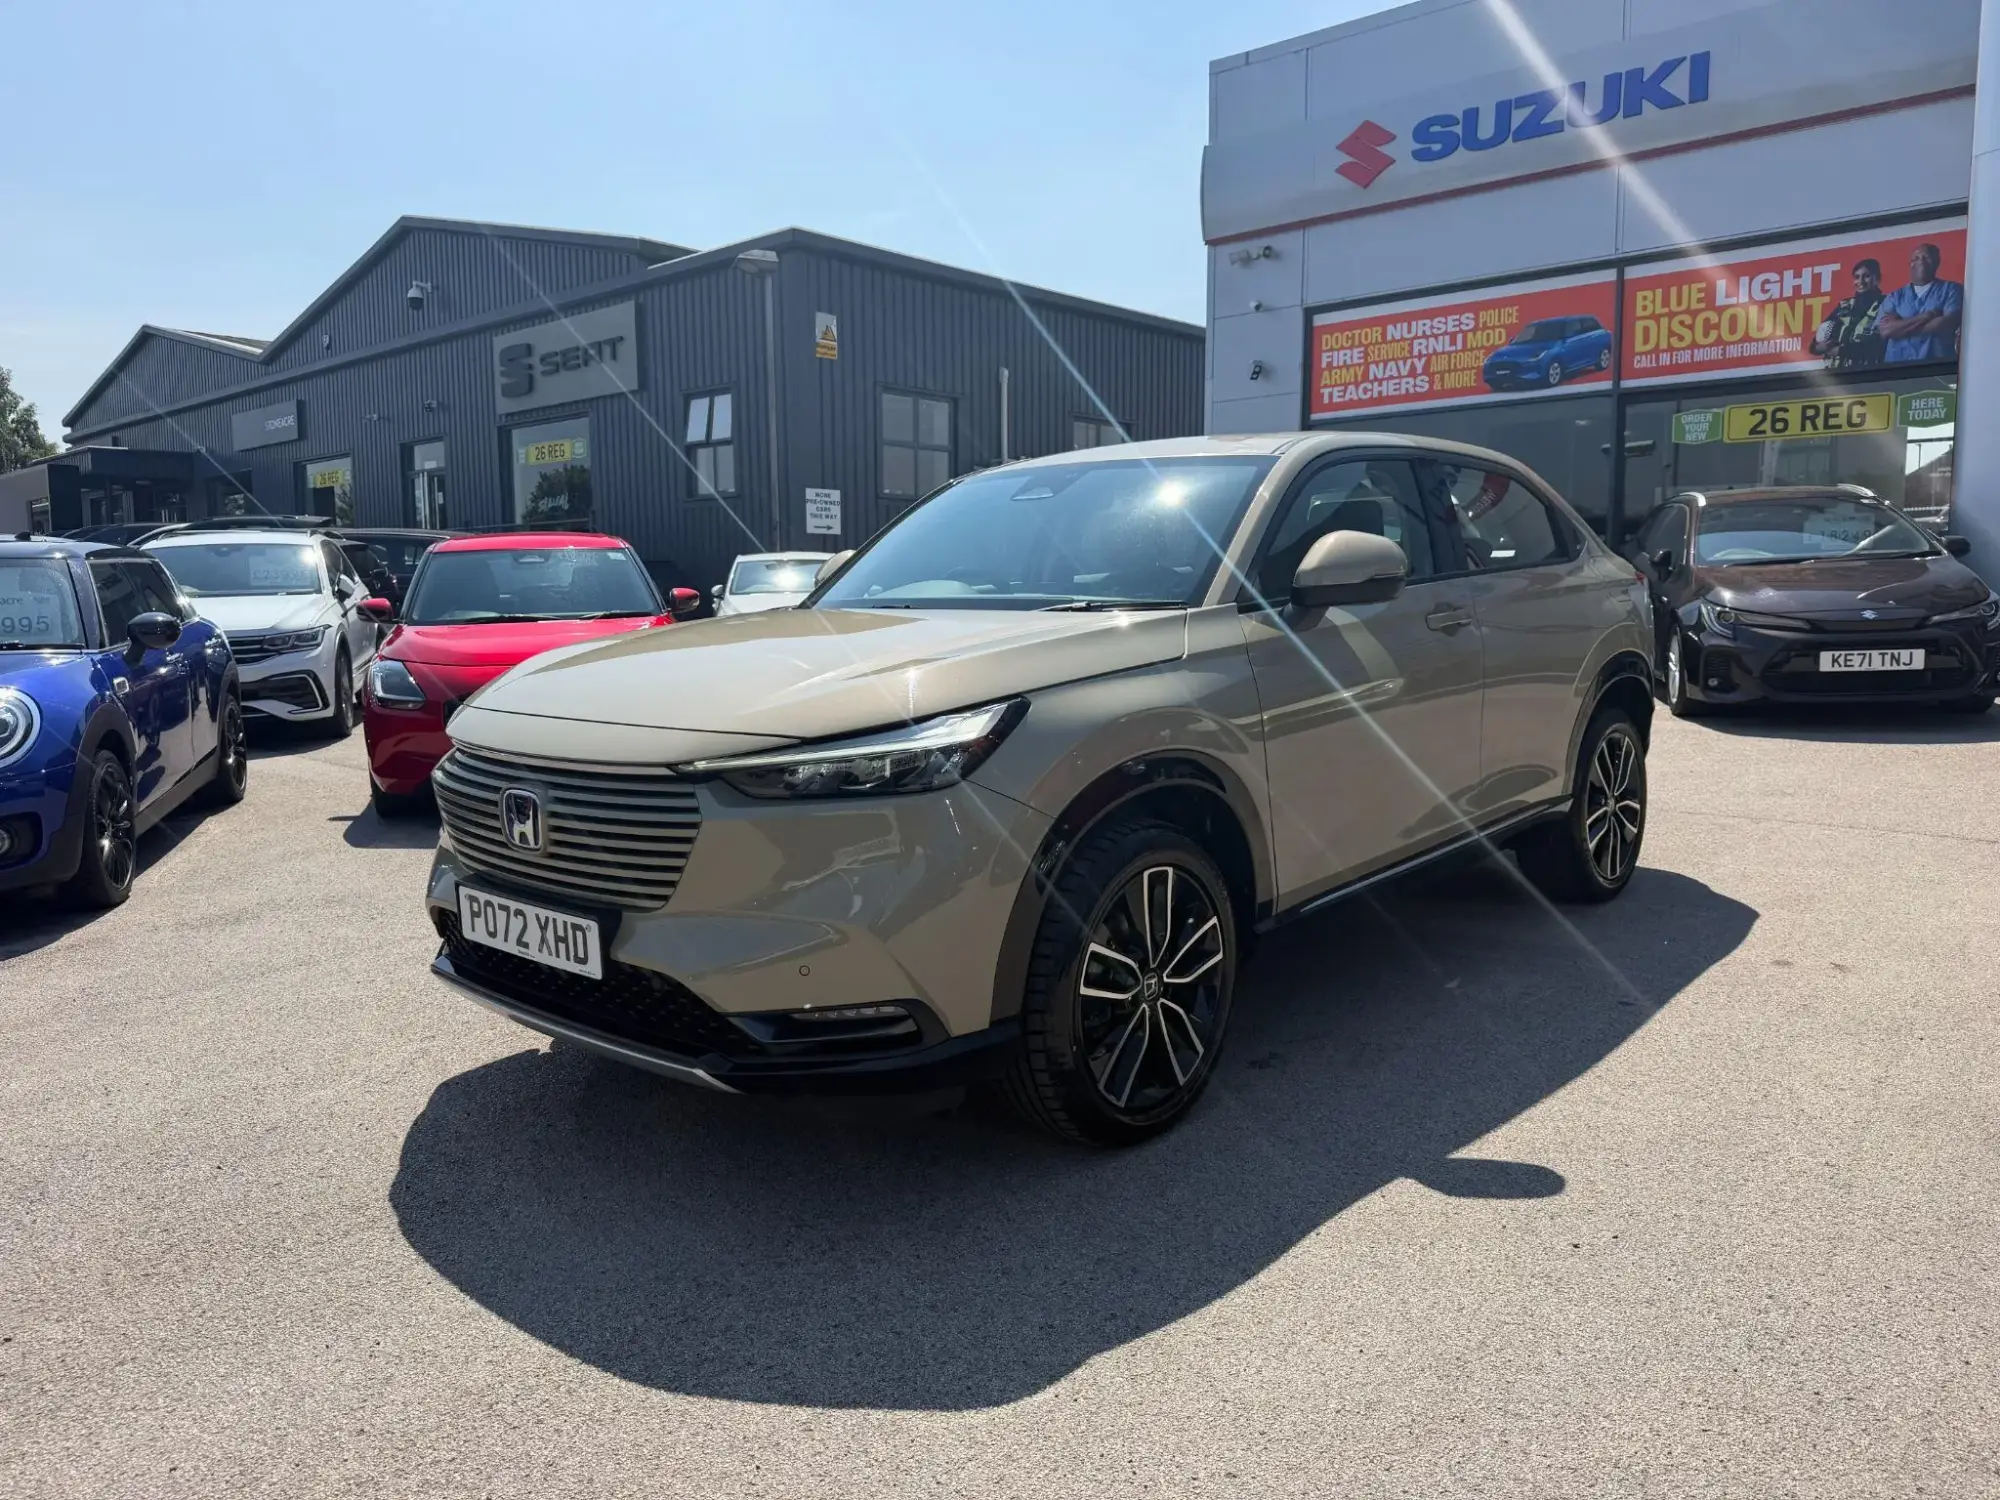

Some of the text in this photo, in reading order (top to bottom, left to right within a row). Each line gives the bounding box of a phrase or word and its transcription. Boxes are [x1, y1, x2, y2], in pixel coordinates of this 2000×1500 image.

[1411, 50, 1710, 162] SUZUKI
[1635, 263, 1841, 317] BLUE LIGHT
[1321, 306, 1519, 350] DOCTOR NURSES POLICE
[1634, 296, 1830, 353] DISCOUNT
[539, 335, 625, 377] SEAT
[1321, 328, 1507, 369] FIRE SERVICE RNLI MOD
[1633, 336, 1802, 369] CALL IN FOR MORE INFORMATION
[1320, 350, 1486, 387] ARMY NAVY AIR FORCE
[1321, 369, 1478, 404] TEACHERS & MORE
[1681, 413, 1713, 425] ORDER
[1748, 400, 1867, 437] 26 REG
[1907, 408, 1948, 421] TODAY
[1911, 397, 1945, 409] HERE
[1684, 422, 1710, 433] YOUR
[1685, 431, 1706, 441] NEW
[535, 446, 545, 460] 26
[547, 443, 565, 459] REG
[1831, 651, 1913, 668] KE71 TNJ
[468, 894, 589, 966] PO72 XHD
